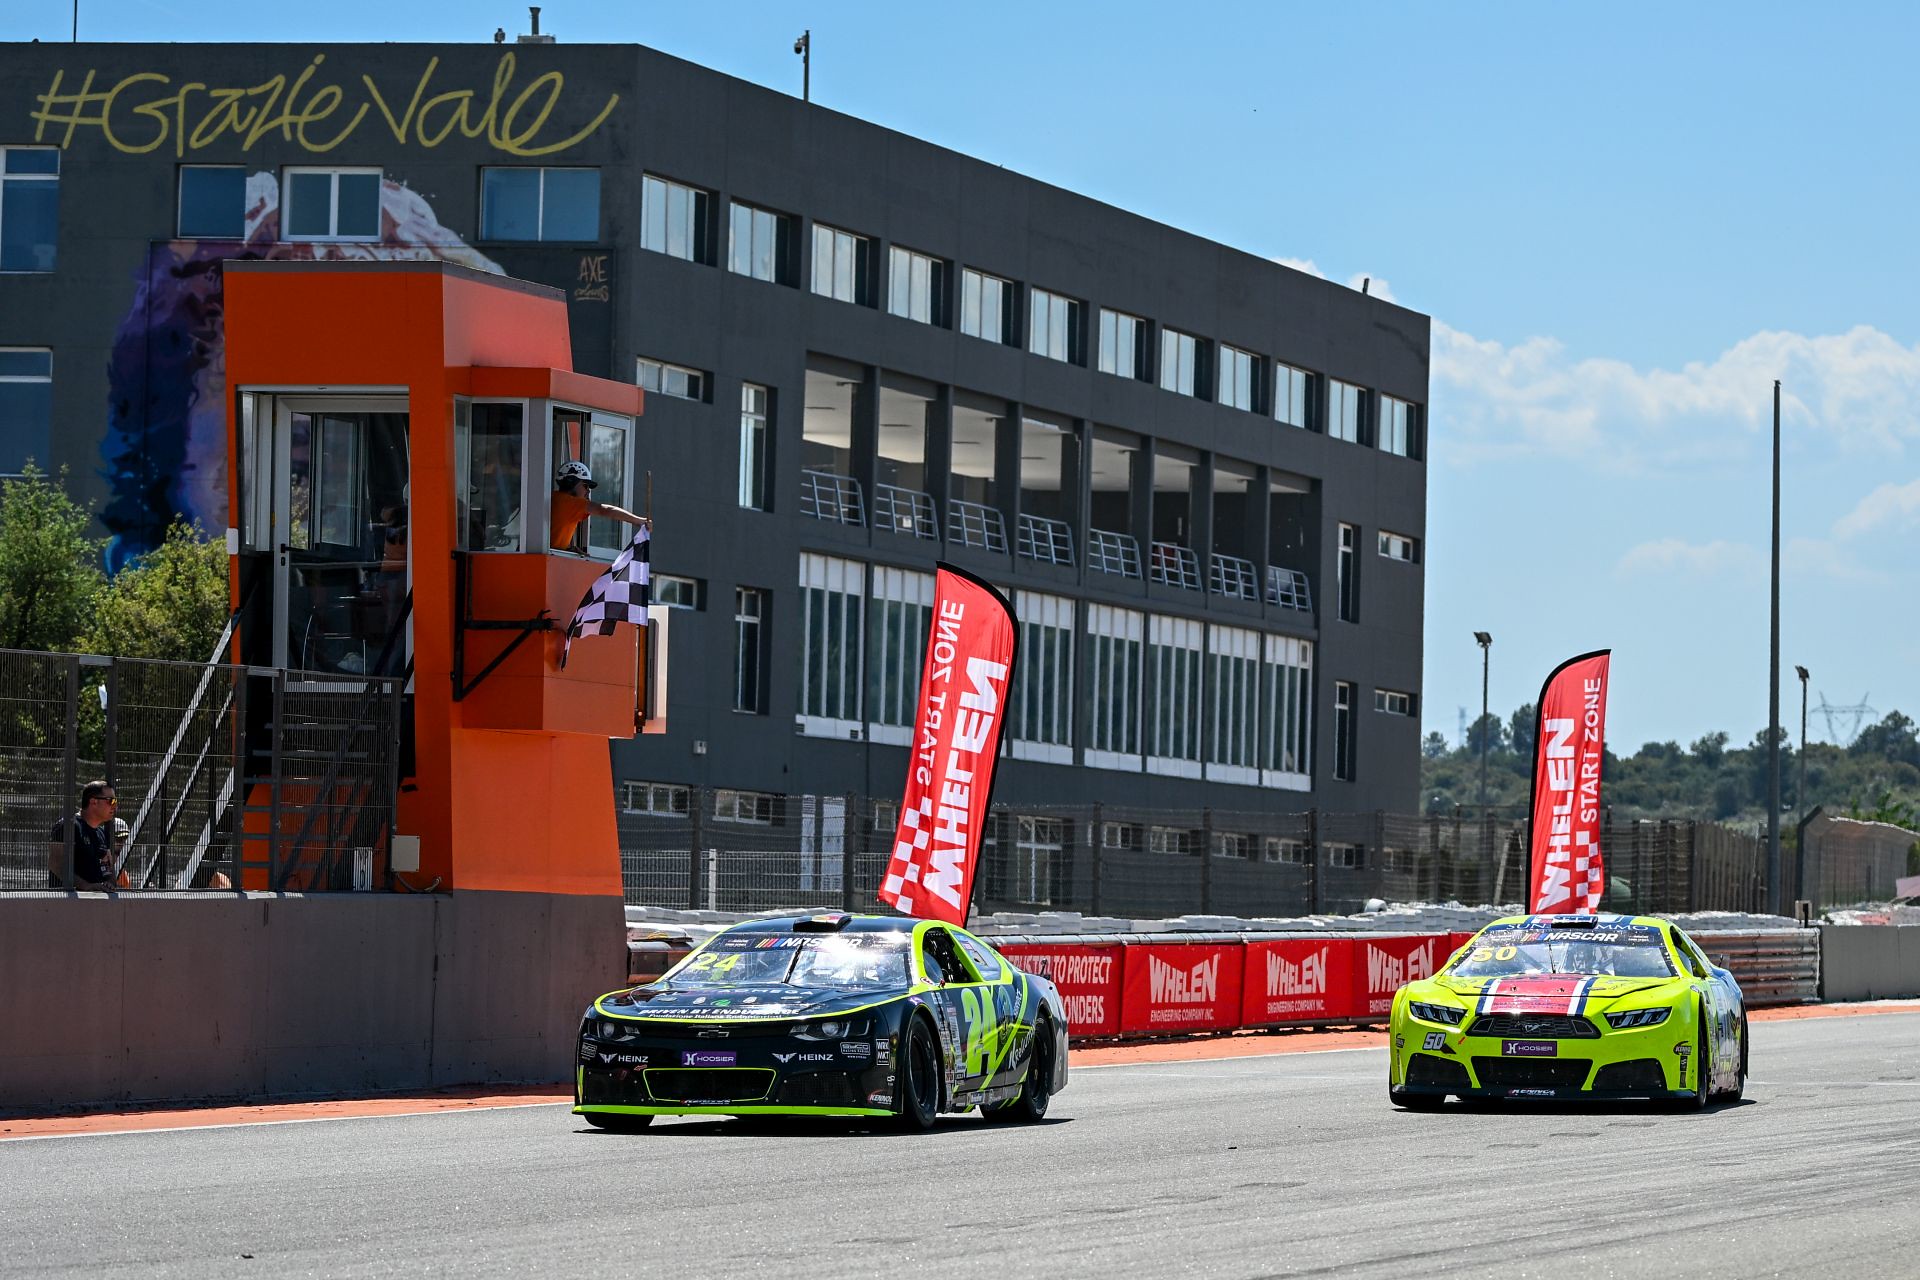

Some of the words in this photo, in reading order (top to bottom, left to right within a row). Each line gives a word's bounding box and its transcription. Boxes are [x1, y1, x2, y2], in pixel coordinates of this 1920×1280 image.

[578, 256, 607, 282] AXE
[1584, 678, 1600, 742] ZONE
[1581, 750, 1598, 823] START
[1536, 718, 1574, 913] WHELEN
[1544, 933, 1618, 942] NASCAR
[690, 953, 740, 972] 24
[1367, 938, 1434, 993] WHELEN
[1472, 946, 1517, 962] 50
[1053, 956, 1067, 984] TO
[1067, 955, 1112, 985] PROTECT
[1150, 953, 1219, 1003] WHELEN
[1267, 947, 1327, 997] WHELEN
[1059, 996, 1104, 1024] ONDERS
[1150, 1010, 1181, 1022] ENGINEERING
[1182, 1009, 1204, 1021] COMPANY
[1268, 1000, 1294, 1014] ENGINEERING
[1294, 999, 1317, 1012] COMPANY
[961, 986, 998, 1078] 24
[1423, 1033, 1445, 1050] 50
[618, 1055, 648, 1063] HEINZ
